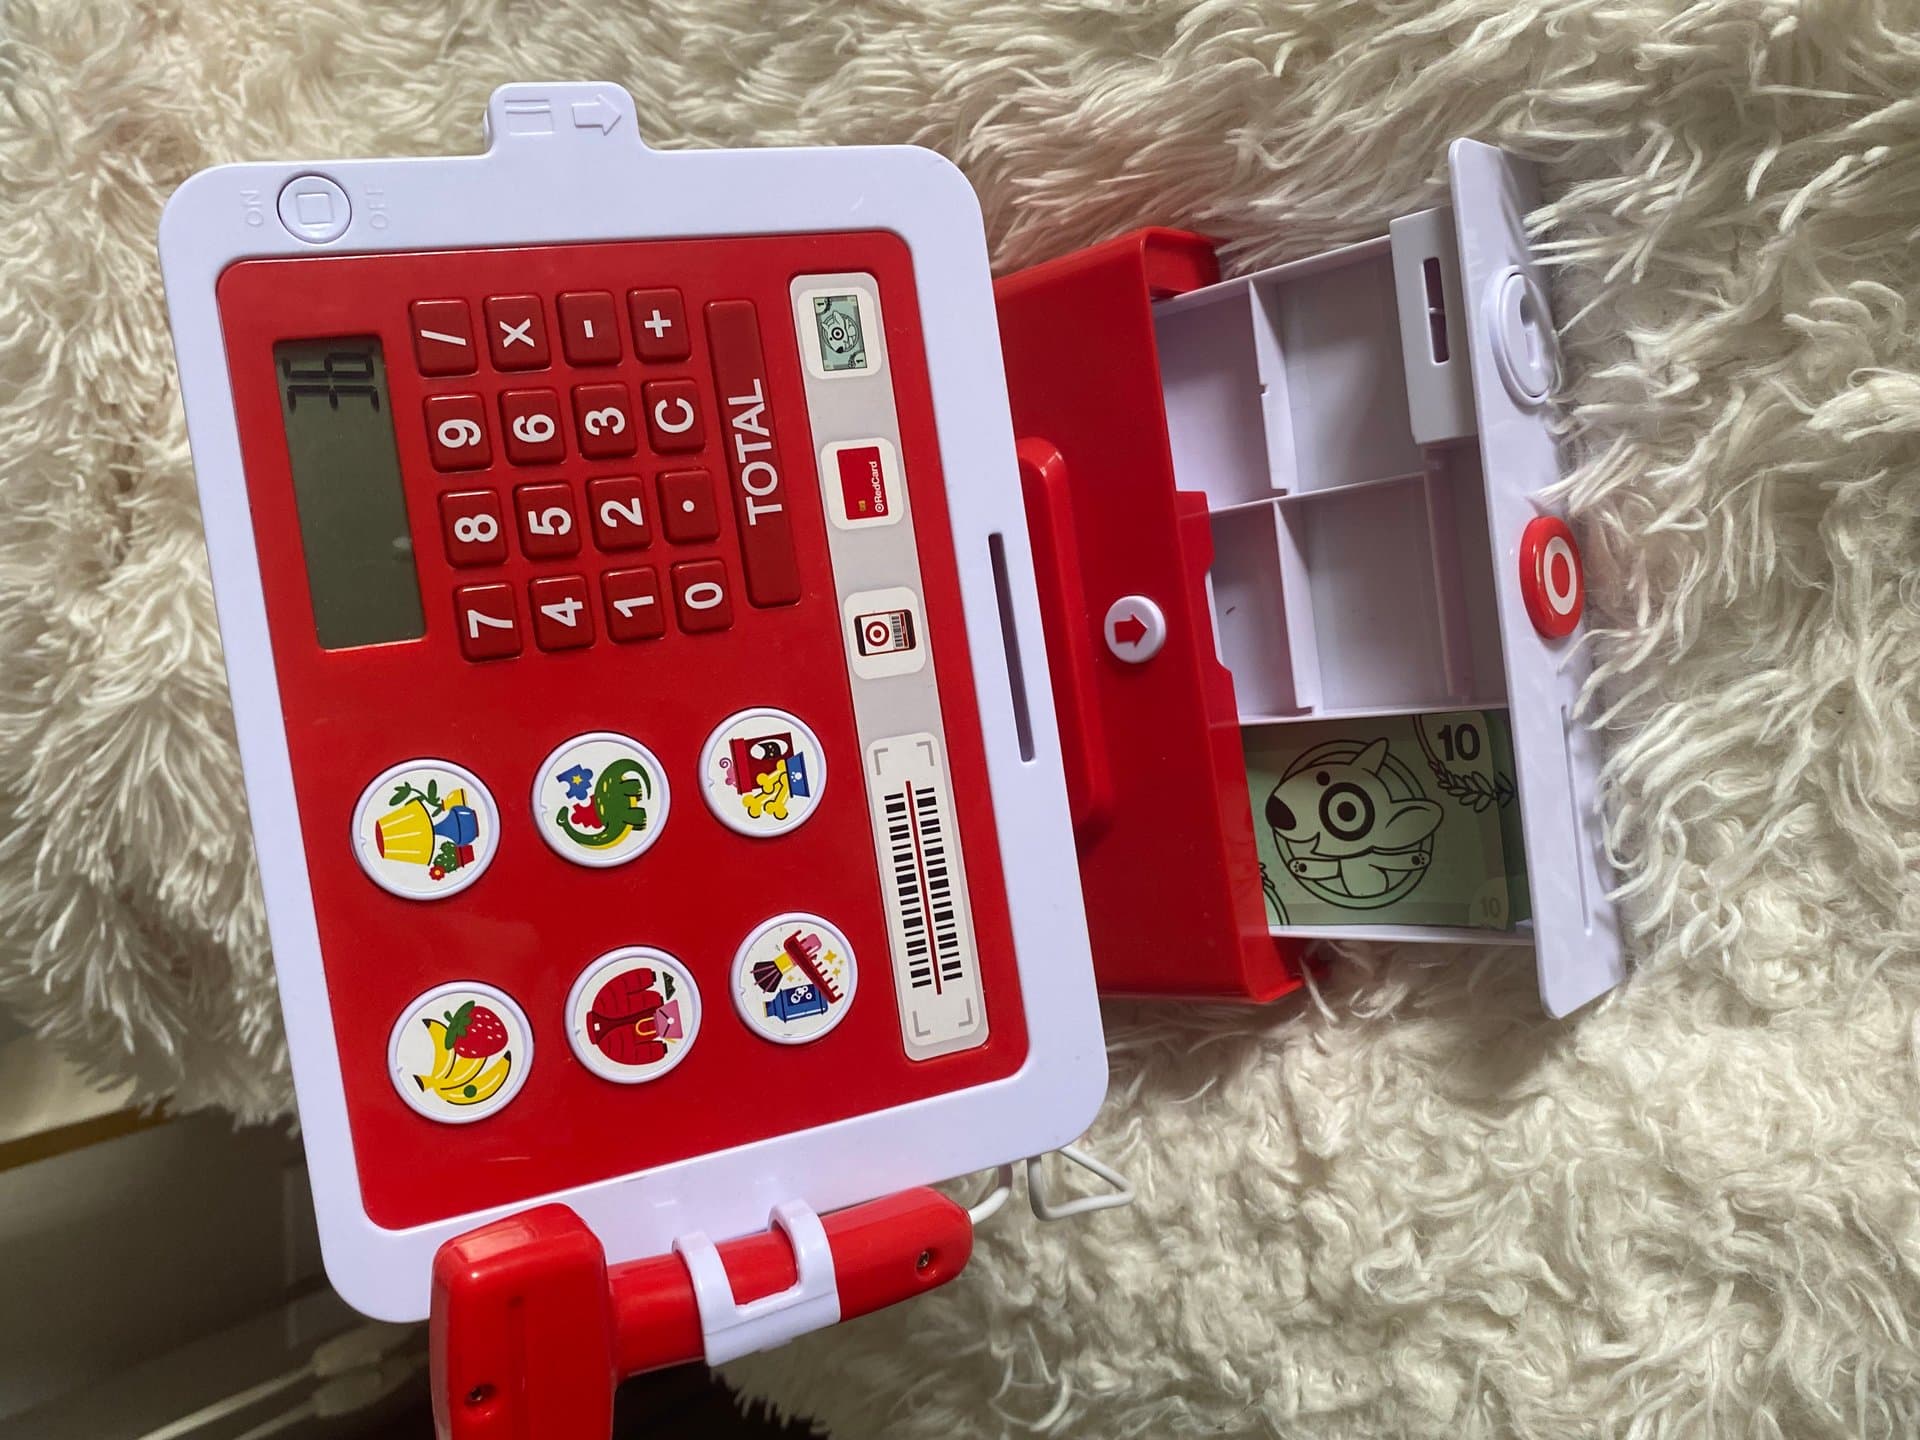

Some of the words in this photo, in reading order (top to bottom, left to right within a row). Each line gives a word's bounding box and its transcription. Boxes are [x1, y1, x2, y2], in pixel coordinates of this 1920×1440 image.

[240, 189, 262, 227] ON
[645, 310, 671, 337] +
[513, 415, 554, 442] 6
[585, 408, 625, 435] 3
[655, 398, 694, 433] C
[438, 420, 481, 447] 9
[728, 379, 782, 525] TOTAL
[869, 461, 882, 503] RedCard
[528, 508, 571, 535] 5
[601, 498, 643, 527] 2
[455, 514, 497, 542] 8
[614, 596, 653, 617] 1
[685, 583, 722, 609] 0
[468, 610, 513, 638] 7
[541, 598, 583, 626] 4
[1438, 722, 1480, 761] 10
